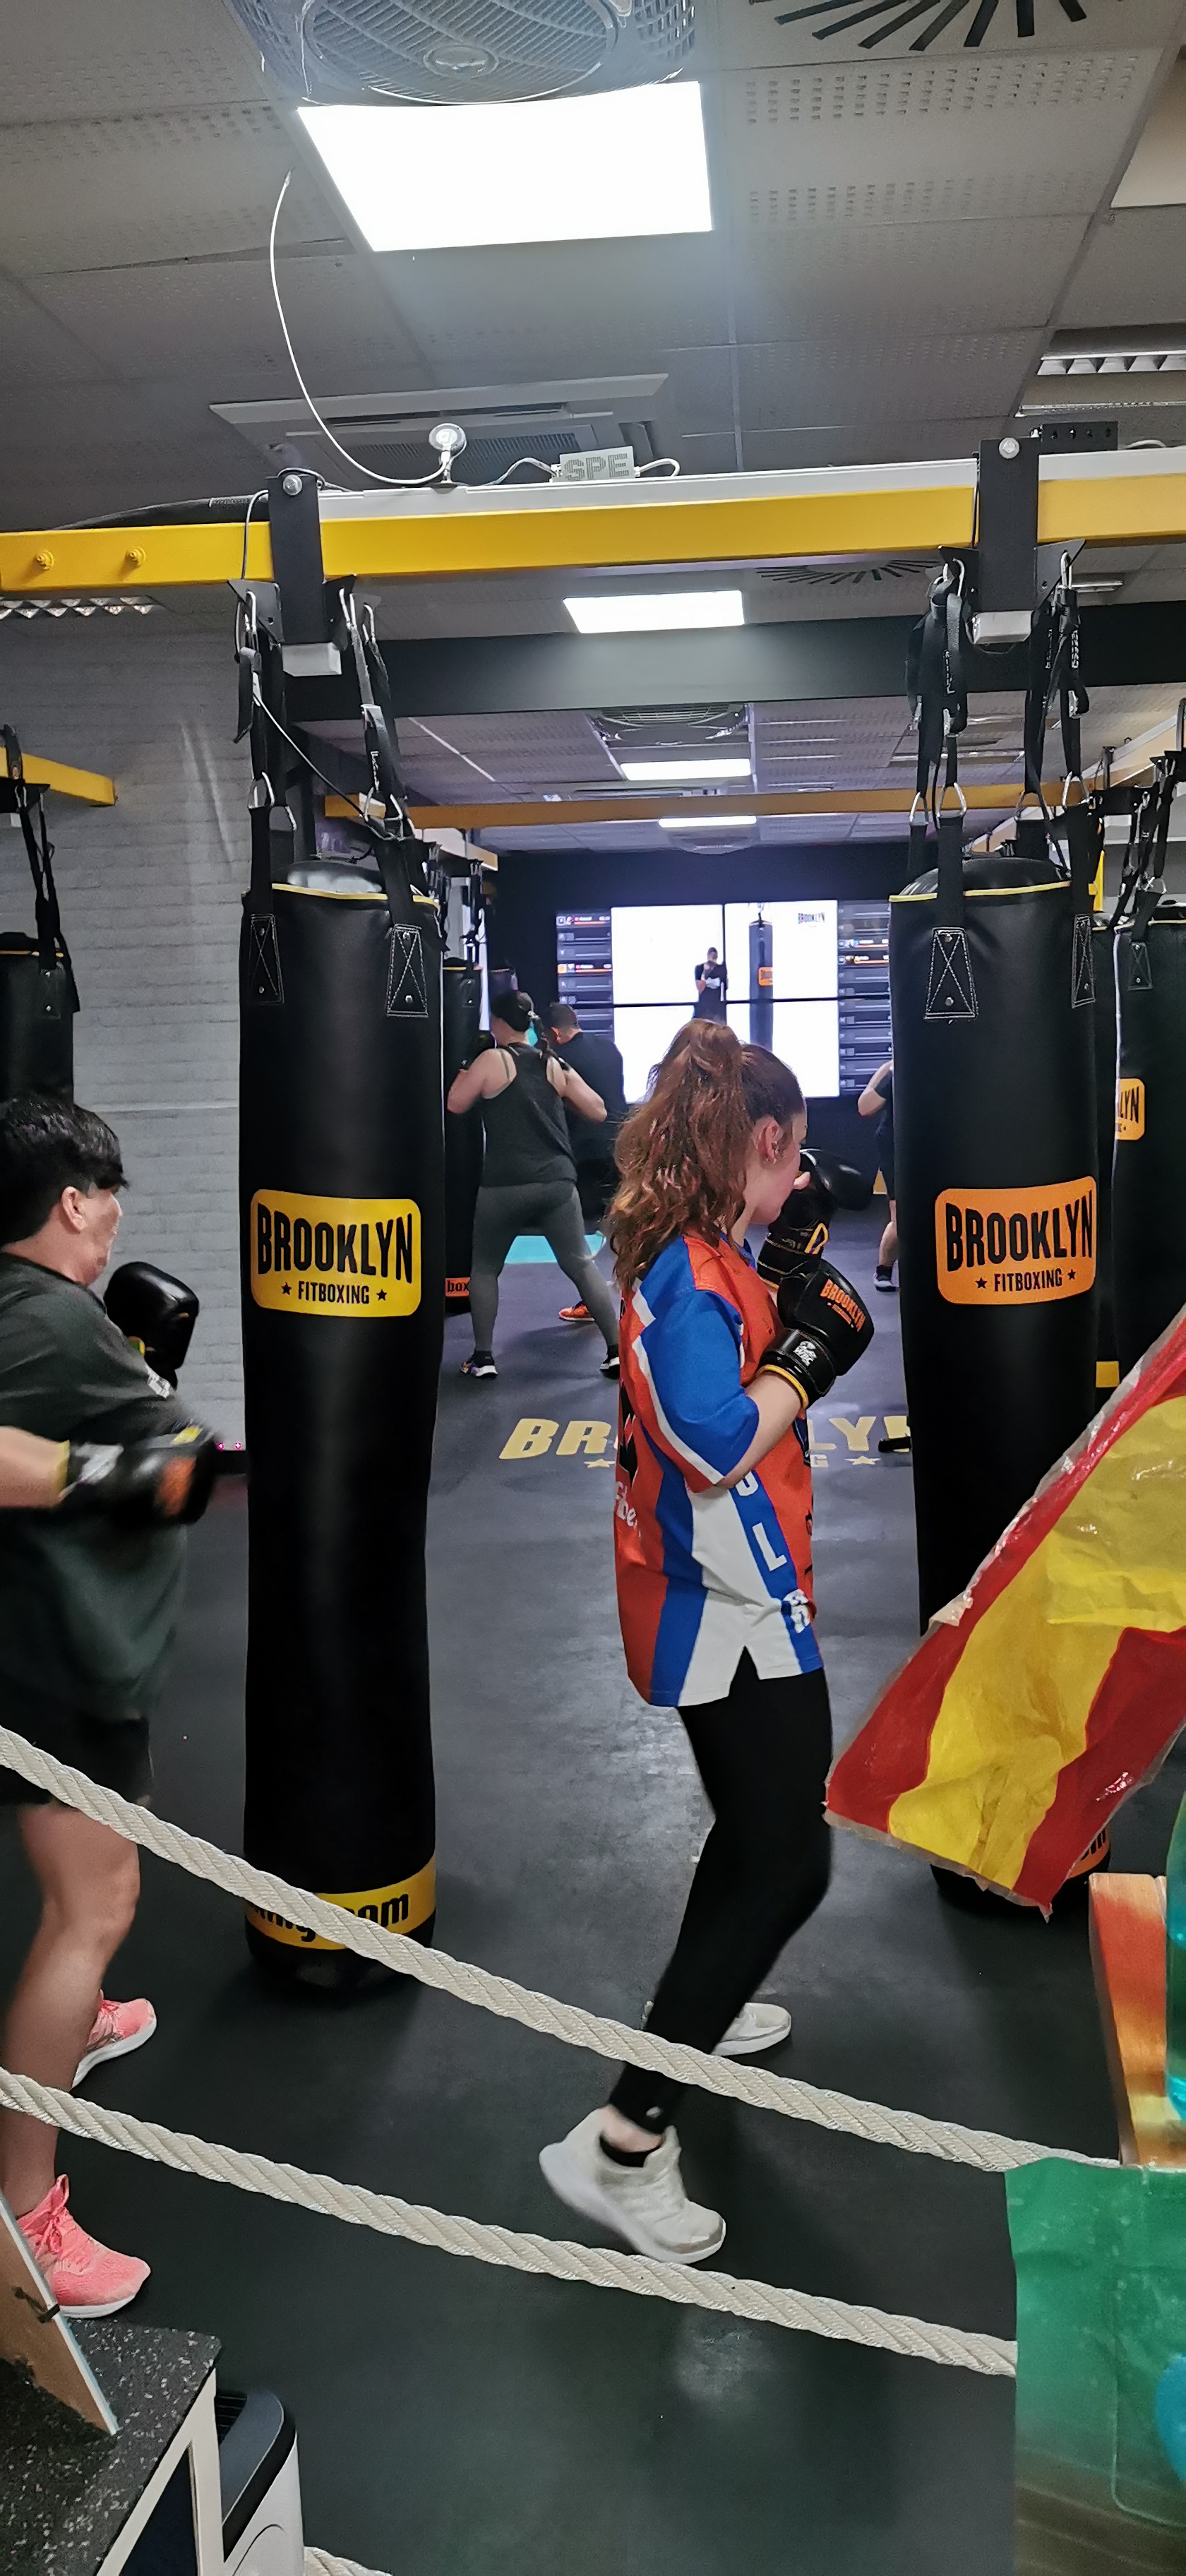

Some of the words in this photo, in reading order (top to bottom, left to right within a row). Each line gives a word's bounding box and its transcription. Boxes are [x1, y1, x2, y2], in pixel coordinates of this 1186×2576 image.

[564, 453, 629, 481] SPE
[257, 1203, 412, 1284] BROOKLYN
[945, 1189, 1093, 1272] BROOKLYN
[298, 1280, 369, 1304] FITBOXING
[994, 1268, 1062, 1292] FITBOXING
[820, 1279, 866, 1332] BROOKLYN
